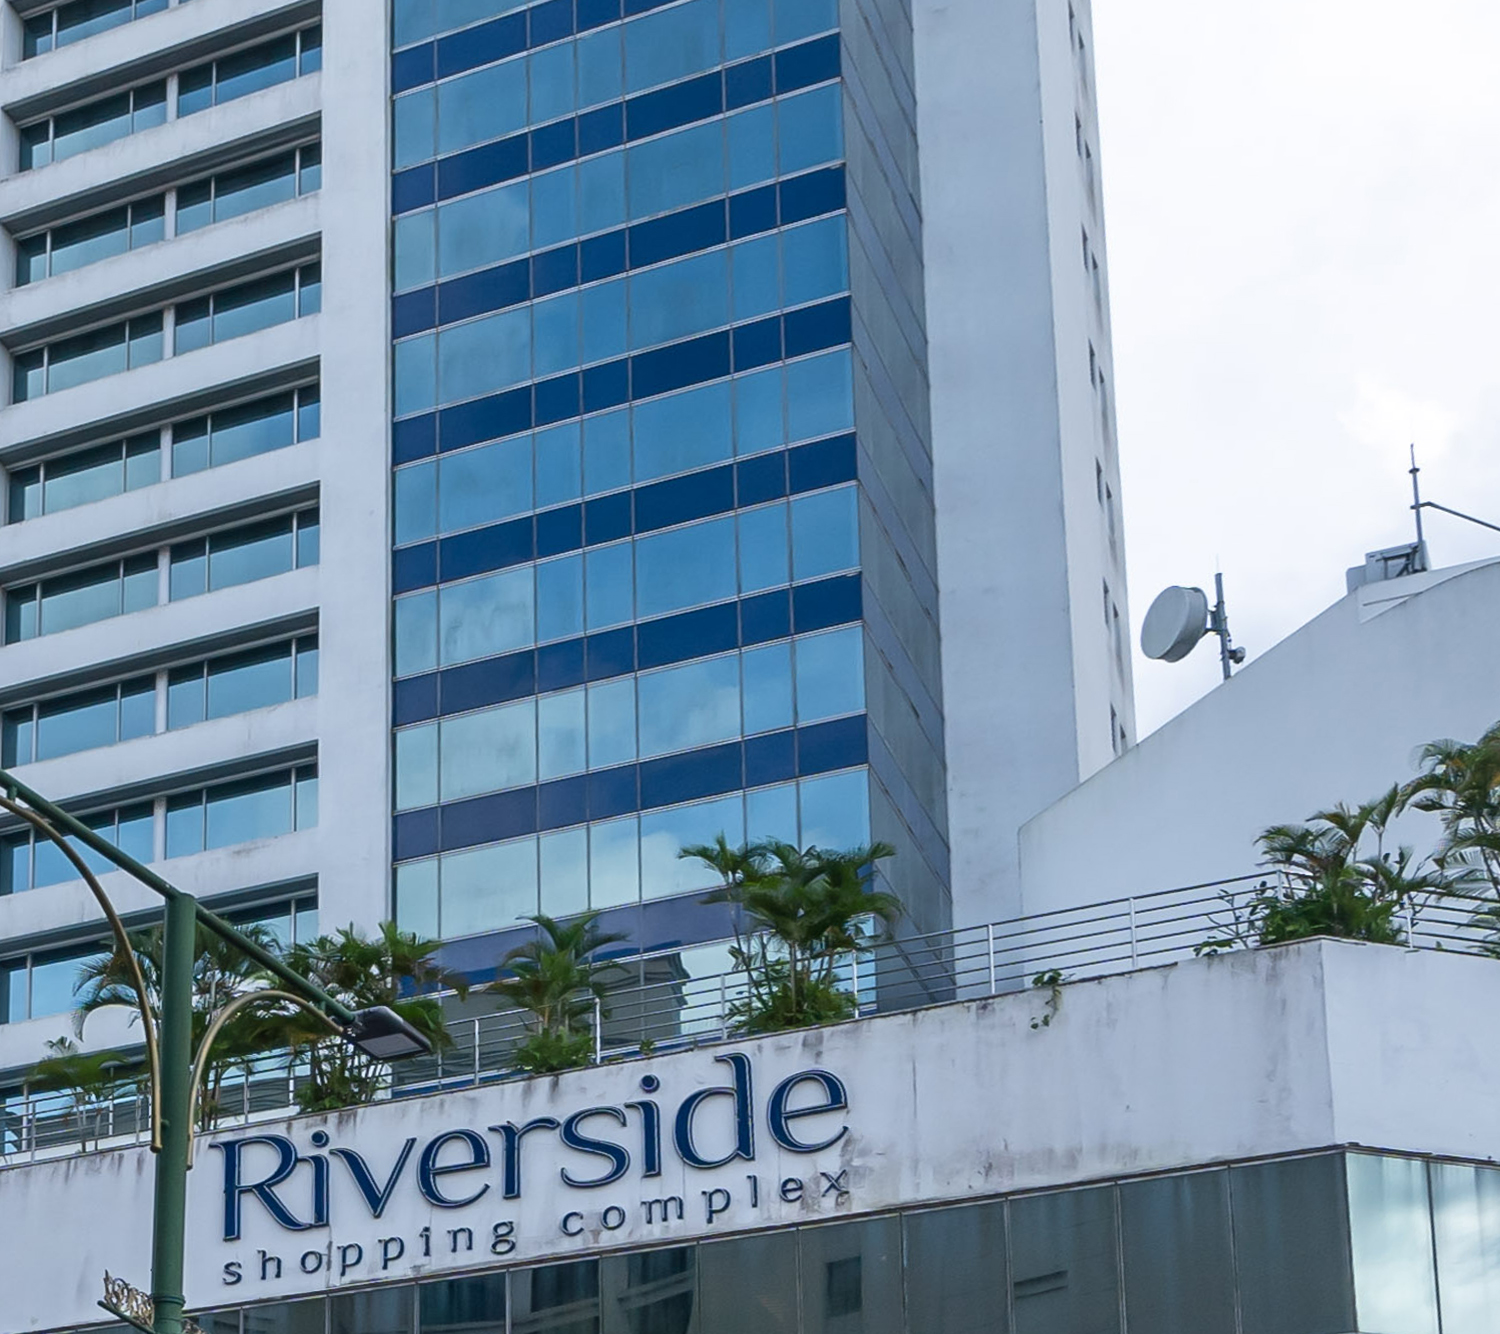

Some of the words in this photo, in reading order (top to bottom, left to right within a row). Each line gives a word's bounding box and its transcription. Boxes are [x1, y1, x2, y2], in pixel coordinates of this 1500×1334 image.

[209, 1053, 851, 1241] Riverside
[222, 1217, 517, 1286] shopping
[562, 1168, 849, 1237] complex
